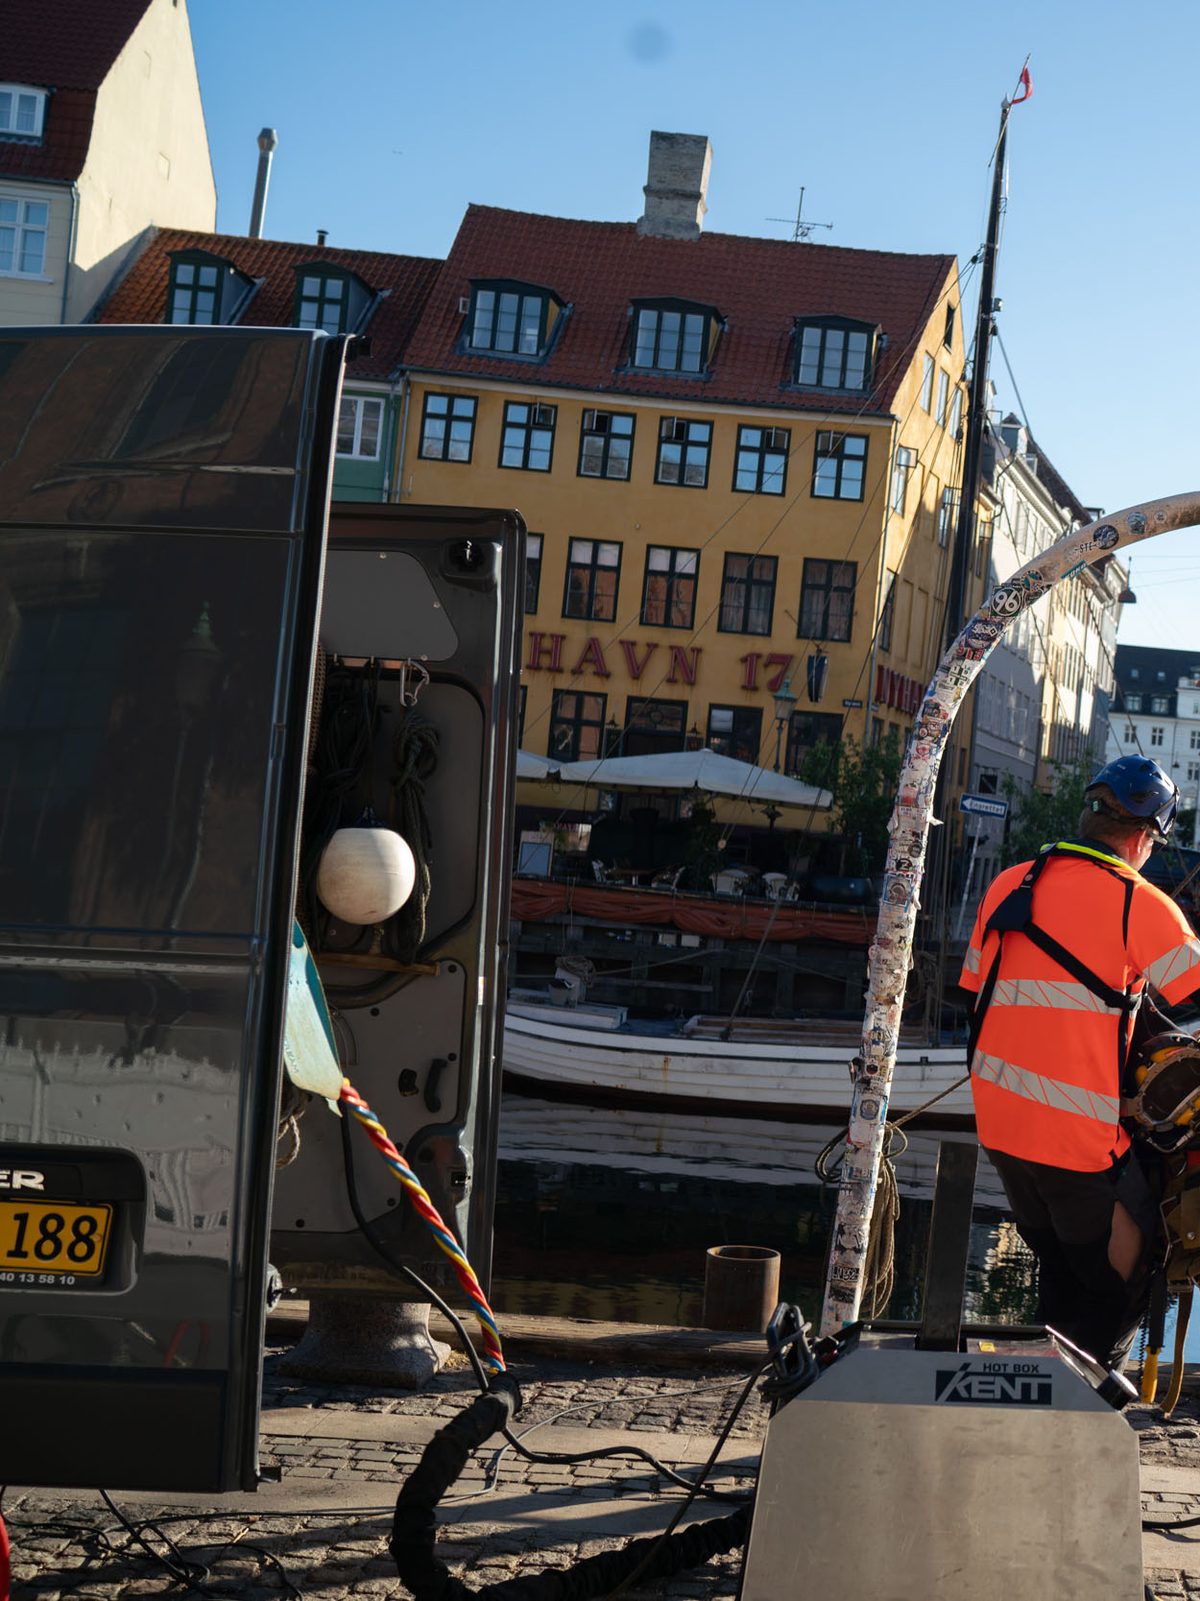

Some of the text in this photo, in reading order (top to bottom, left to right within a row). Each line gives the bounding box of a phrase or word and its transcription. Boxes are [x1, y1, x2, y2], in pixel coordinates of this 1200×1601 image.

[994, 591, 1021, 613] 96
[740, 653, 794, 691] 17
[0, 1169, 45, 1191] ER
[6, 1212, 98, 1263] 188
[19, 1273, 35, 1283] 13
[39, 1274, 55, 1284] 58
[60, 1275, 75, 1285] 10
[983, 1363, 1040, 1374] HOT BOX
[937, 1362, 1052, 1402] KENT
